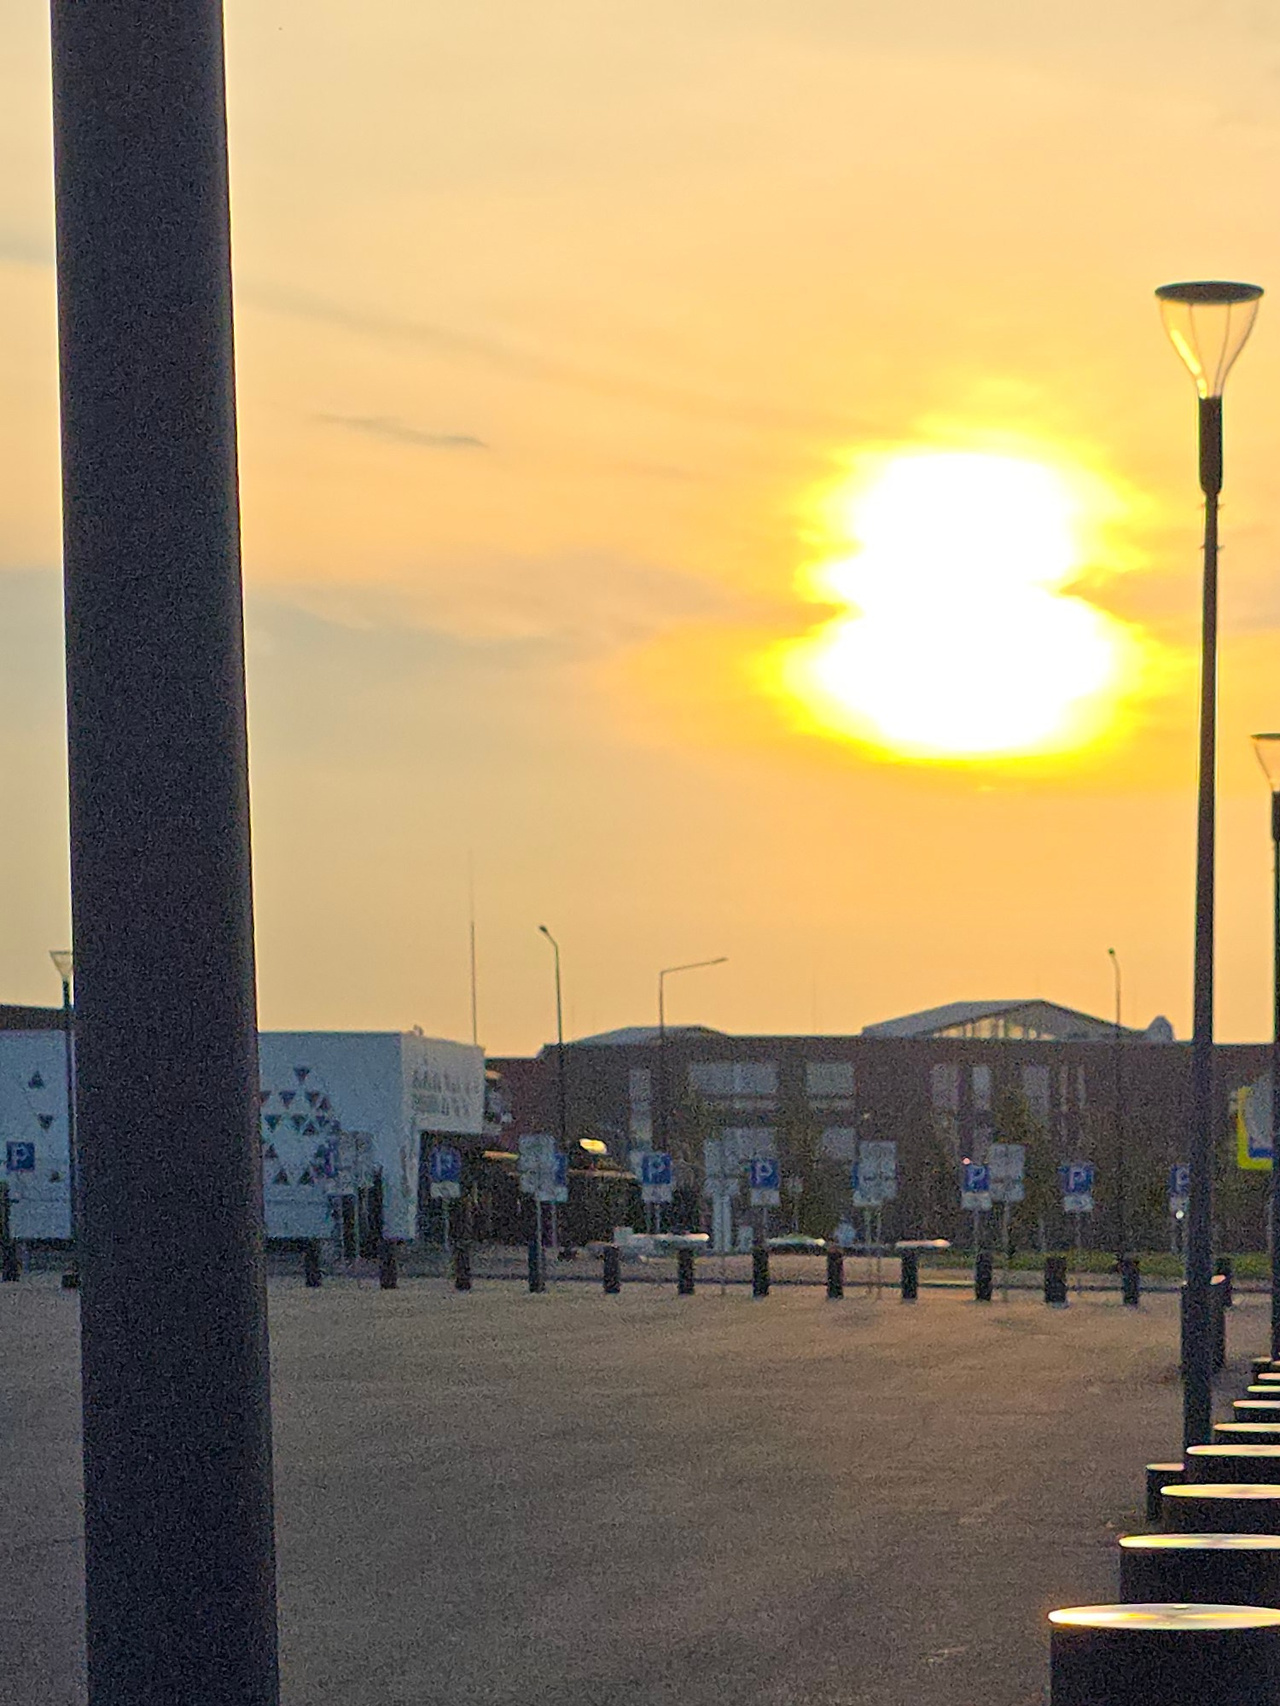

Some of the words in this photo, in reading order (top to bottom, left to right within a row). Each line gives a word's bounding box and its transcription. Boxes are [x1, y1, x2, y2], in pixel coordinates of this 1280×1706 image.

[12, 1143, 29, 1167] P
[648, 1155, 665, 1179] P
[756, 1161, 772, 1185] P
[968, 1165, 985, 1188] P
[1070, 1166, 1086, 1189] P
